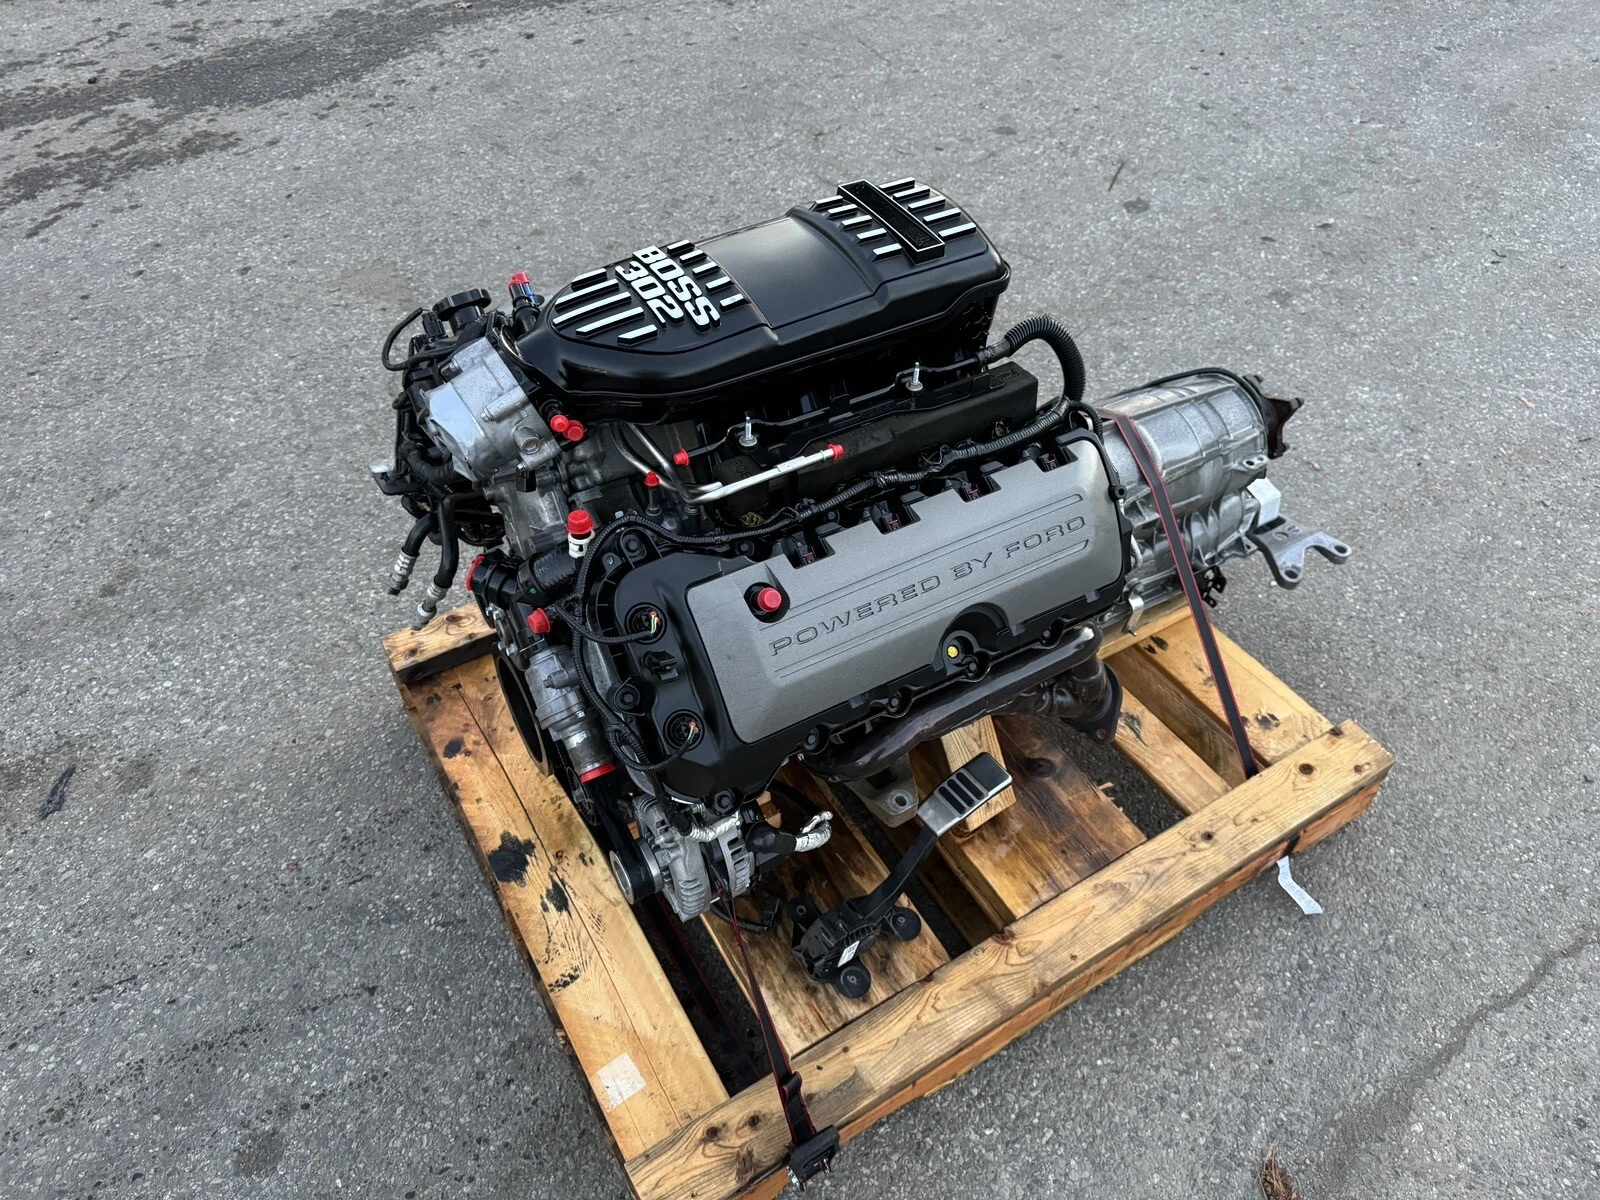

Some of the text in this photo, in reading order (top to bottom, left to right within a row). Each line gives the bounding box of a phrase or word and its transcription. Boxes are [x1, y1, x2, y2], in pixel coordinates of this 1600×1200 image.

[615, 260, 684, 324] 302
[632, 245, 720, 326] BOSS
[767, 515, 1086, 656] POWERED BY FORD
